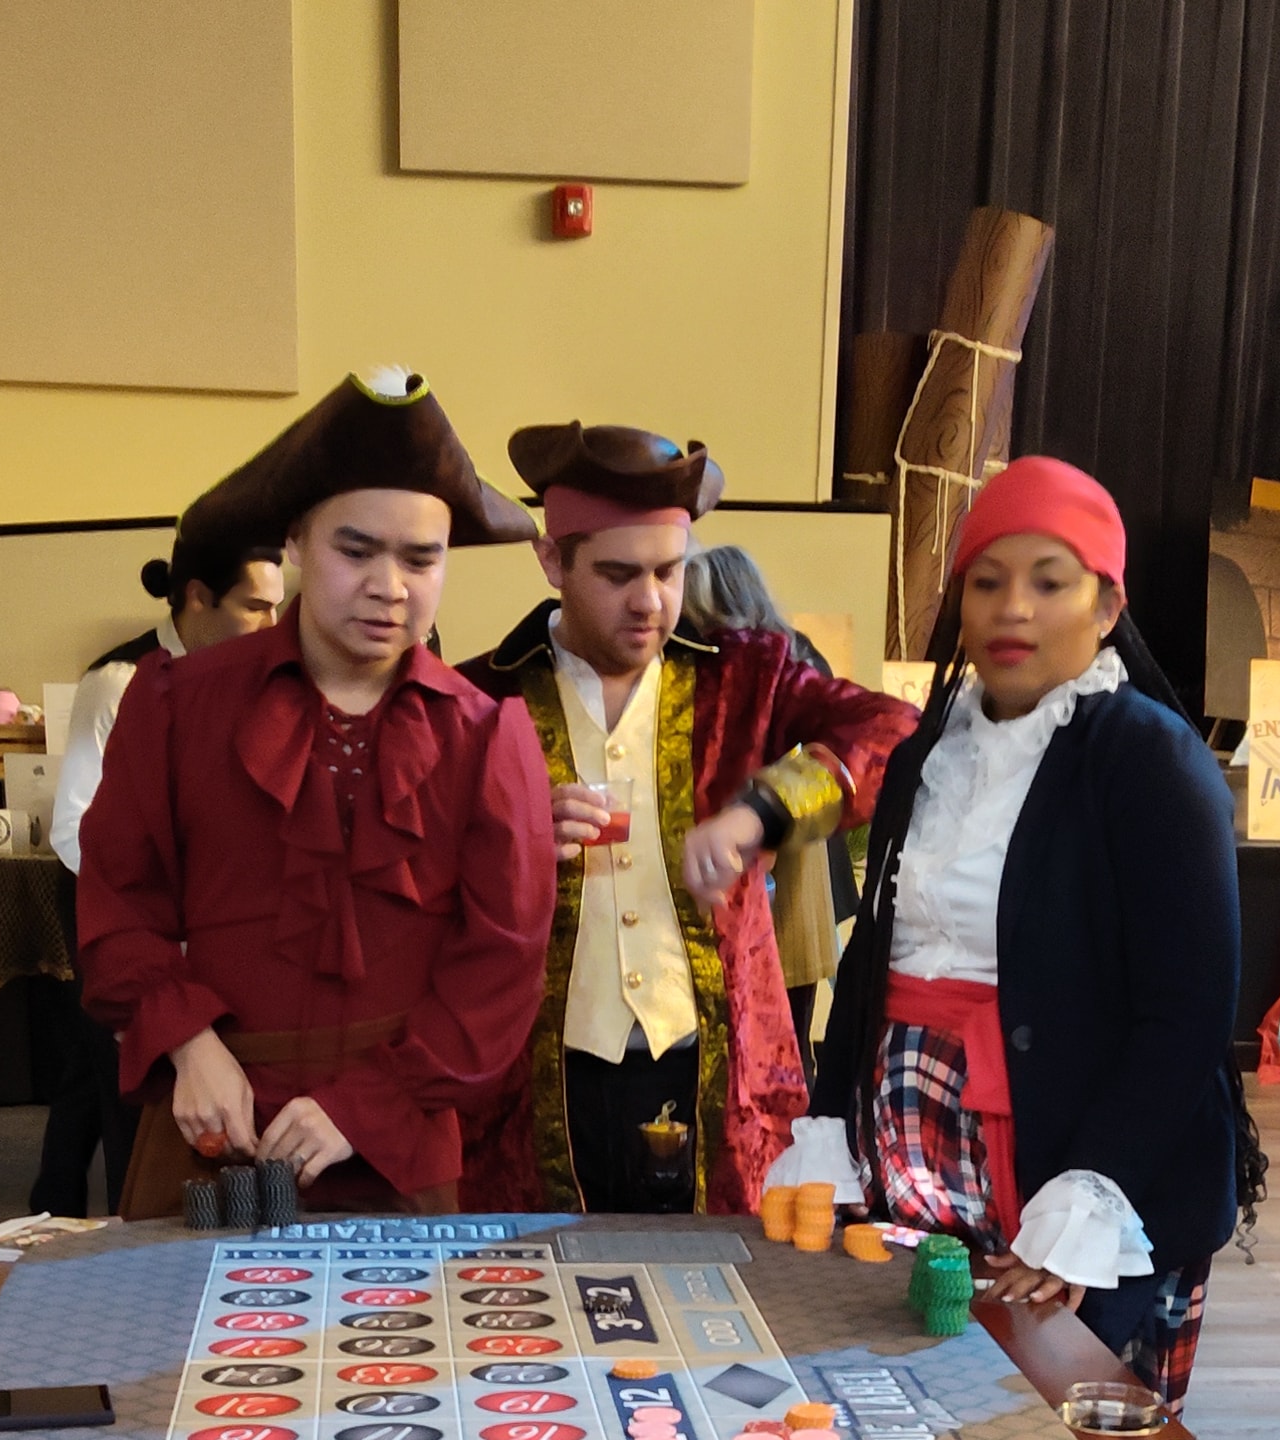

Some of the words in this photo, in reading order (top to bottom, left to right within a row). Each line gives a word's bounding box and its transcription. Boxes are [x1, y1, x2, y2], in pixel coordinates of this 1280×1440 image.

[271, 1224, 383, 1239] LABEL
[410, 1224, 505, 1239] BLUE
[245, 1269, 299, 1282] 36
[362, 1269, 417, 1282] 35
[234, 1290, 296, 1304] 33
[356, 1290, 416, 1304] 32
[480, 1290, 529, 1304] 31
[226, 1315, 294, 1329] 30
[222, 1339, 293, 1356] 27
[356, 1339, 418, 1354] 26
[486, 1339, 548, 1354] 25
[215, 1367, 277, 1384] 24
[351, 1367, 412, 1384] 23
[485, 1366, 545, 1382] 22
[832, 1368, 917, 1416] LABEL
[215, 1397, 277, 1416] 21
[346, 1394, 417, 1414] 20
[499, 1394, 549, 1412] 19
